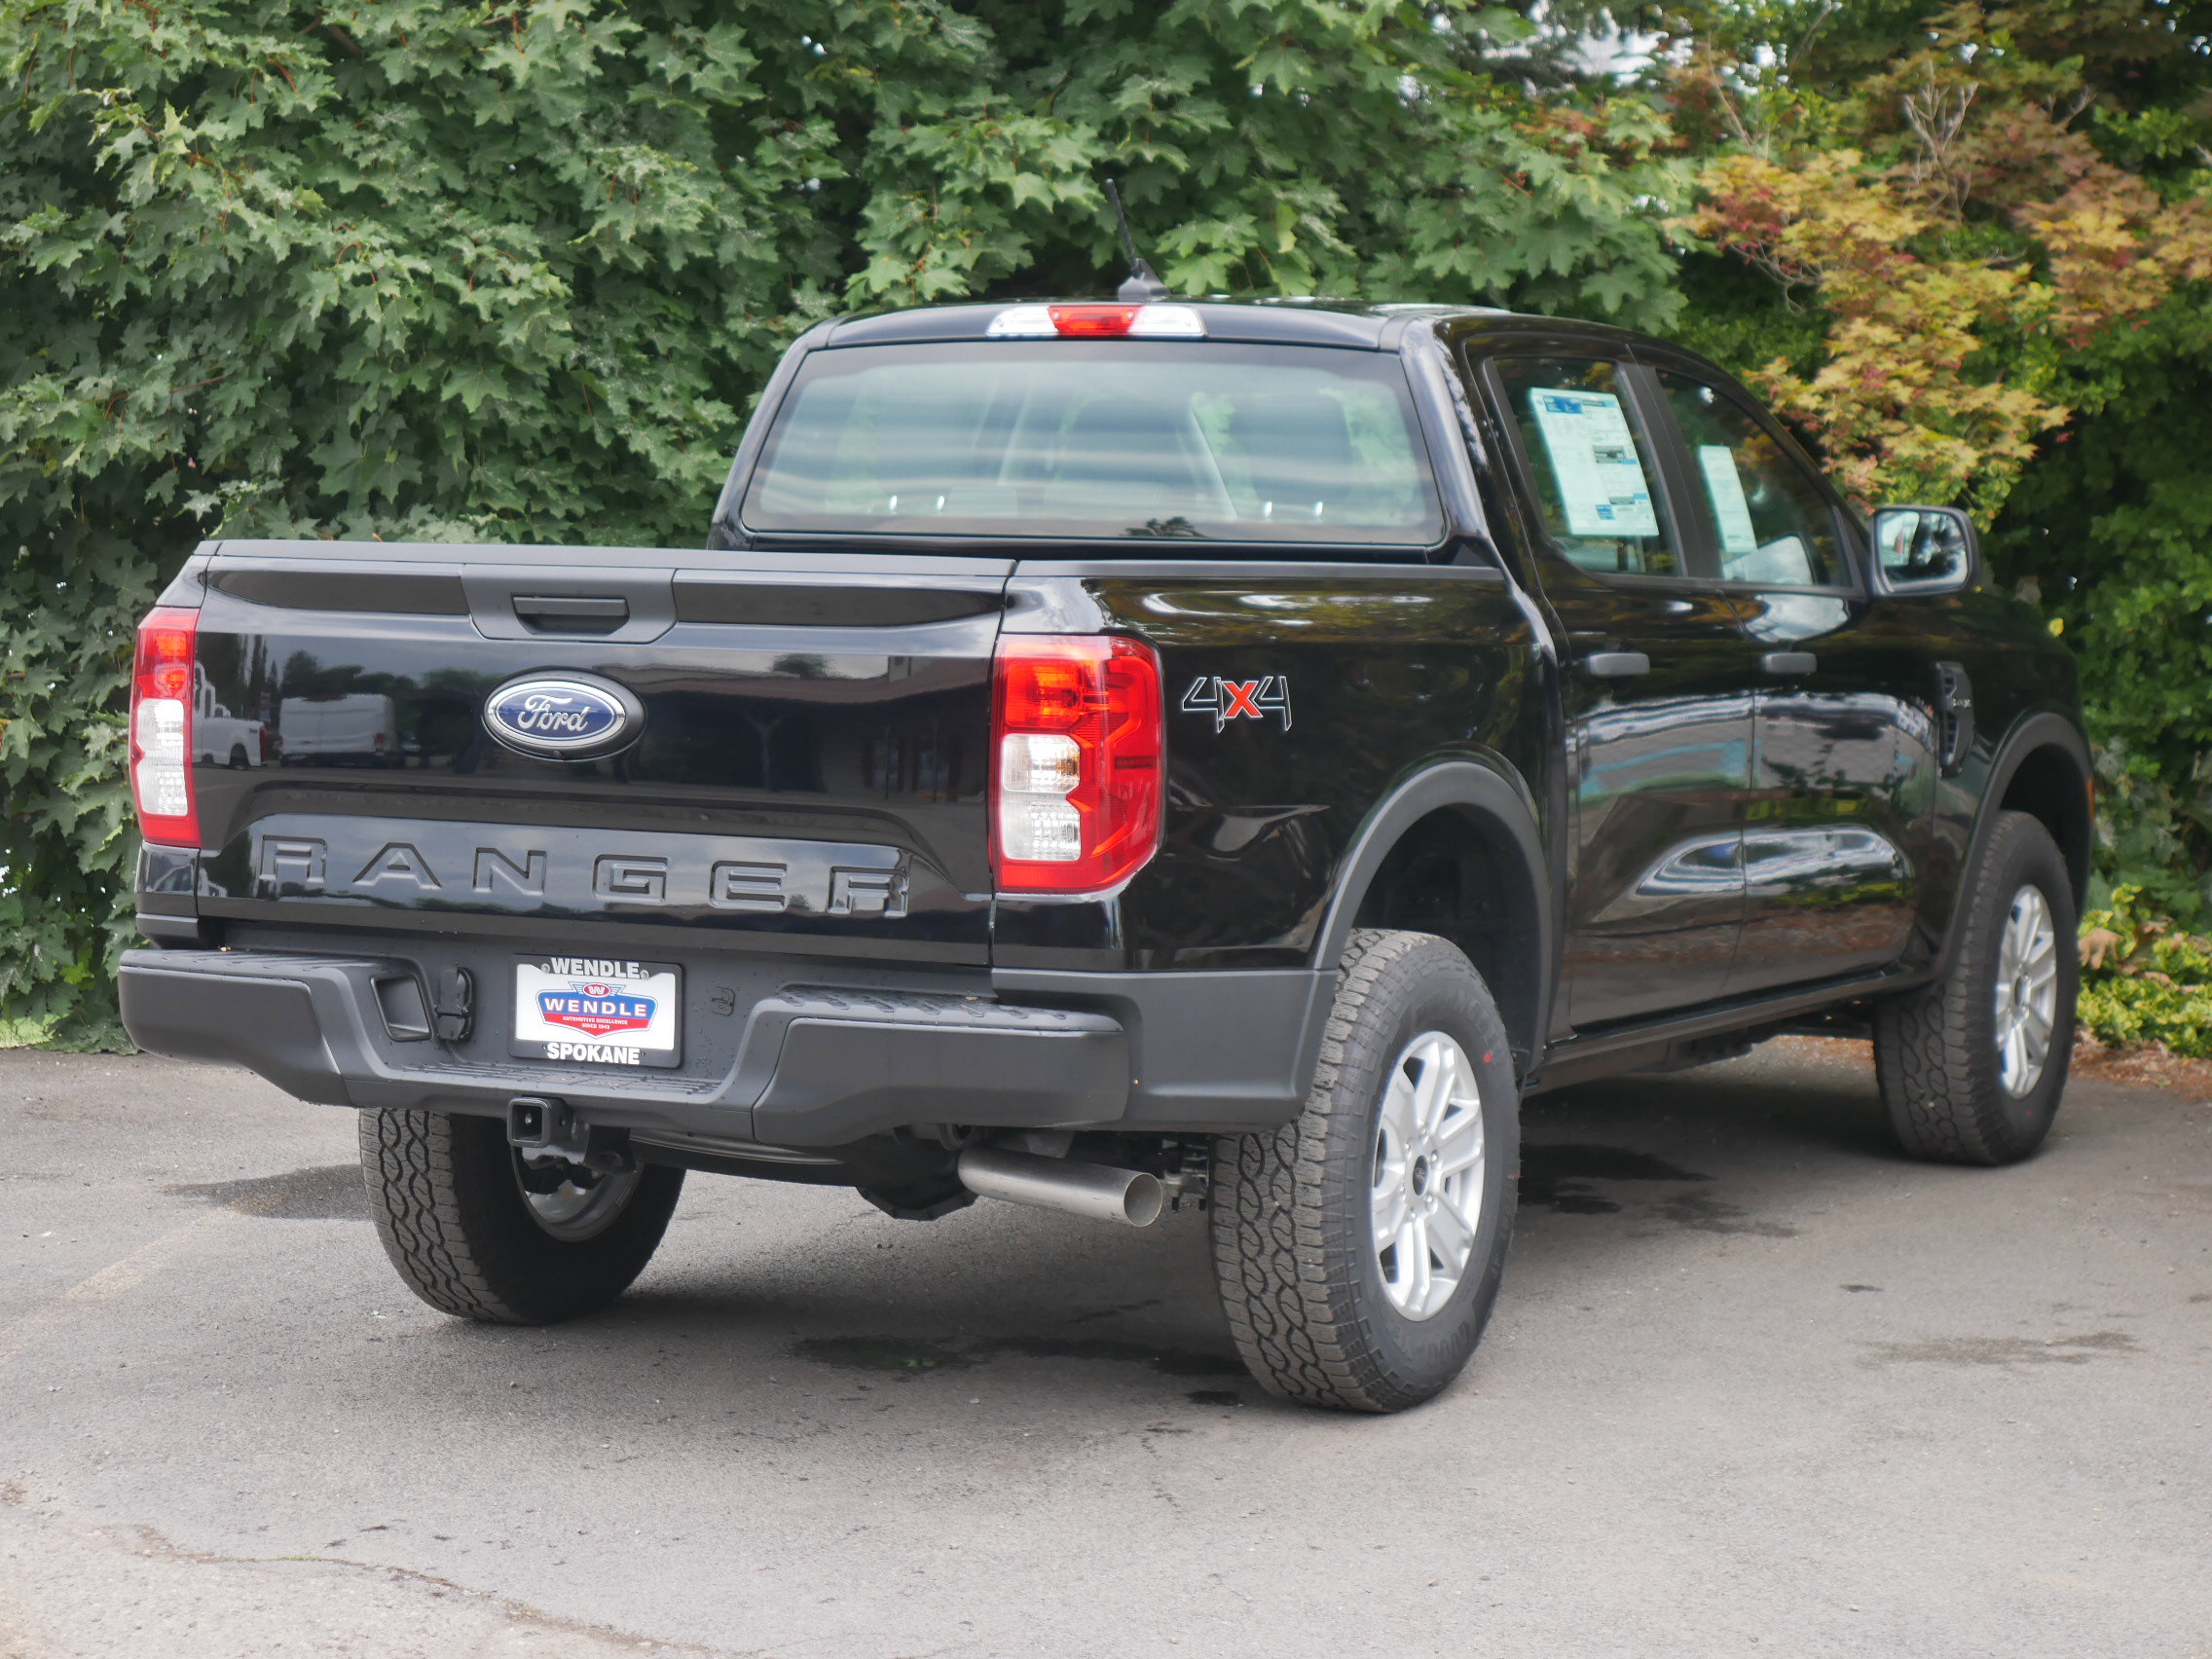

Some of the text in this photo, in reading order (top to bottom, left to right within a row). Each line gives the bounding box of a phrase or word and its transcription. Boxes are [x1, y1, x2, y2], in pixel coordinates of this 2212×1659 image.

[517, 694, 591, 731] Ford
[259, 834, 910, 918] RANGER
[550, 957, 642, 979] WENDLE
[587, 985, 606, 995] W
[544, 998, 645, 1016] WENDLE
[546, 1042, 641, 1065] SPOKANE
